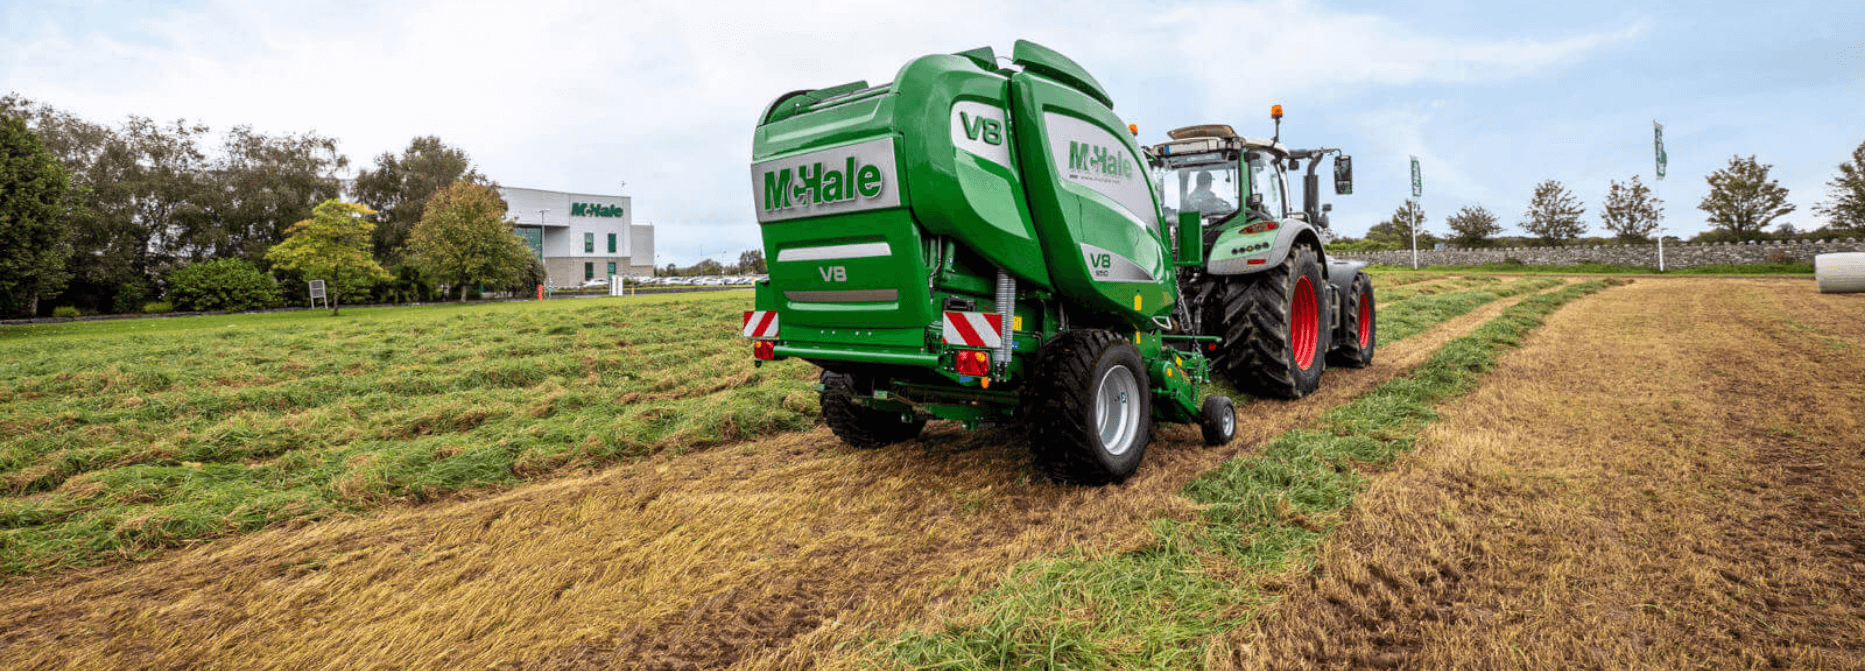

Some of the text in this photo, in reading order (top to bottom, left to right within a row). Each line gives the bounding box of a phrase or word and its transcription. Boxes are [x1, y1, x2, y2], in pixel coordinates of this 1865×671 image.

[960, 111, 1002, 145] V8
[1069, 140, 1132, 178] McHale
[764, 156, 881, 210] McHale
[571, 202, 623, 218] McHale
[1090, 253, 1111, 268] V8
[819, 265, 847, 282] V8
